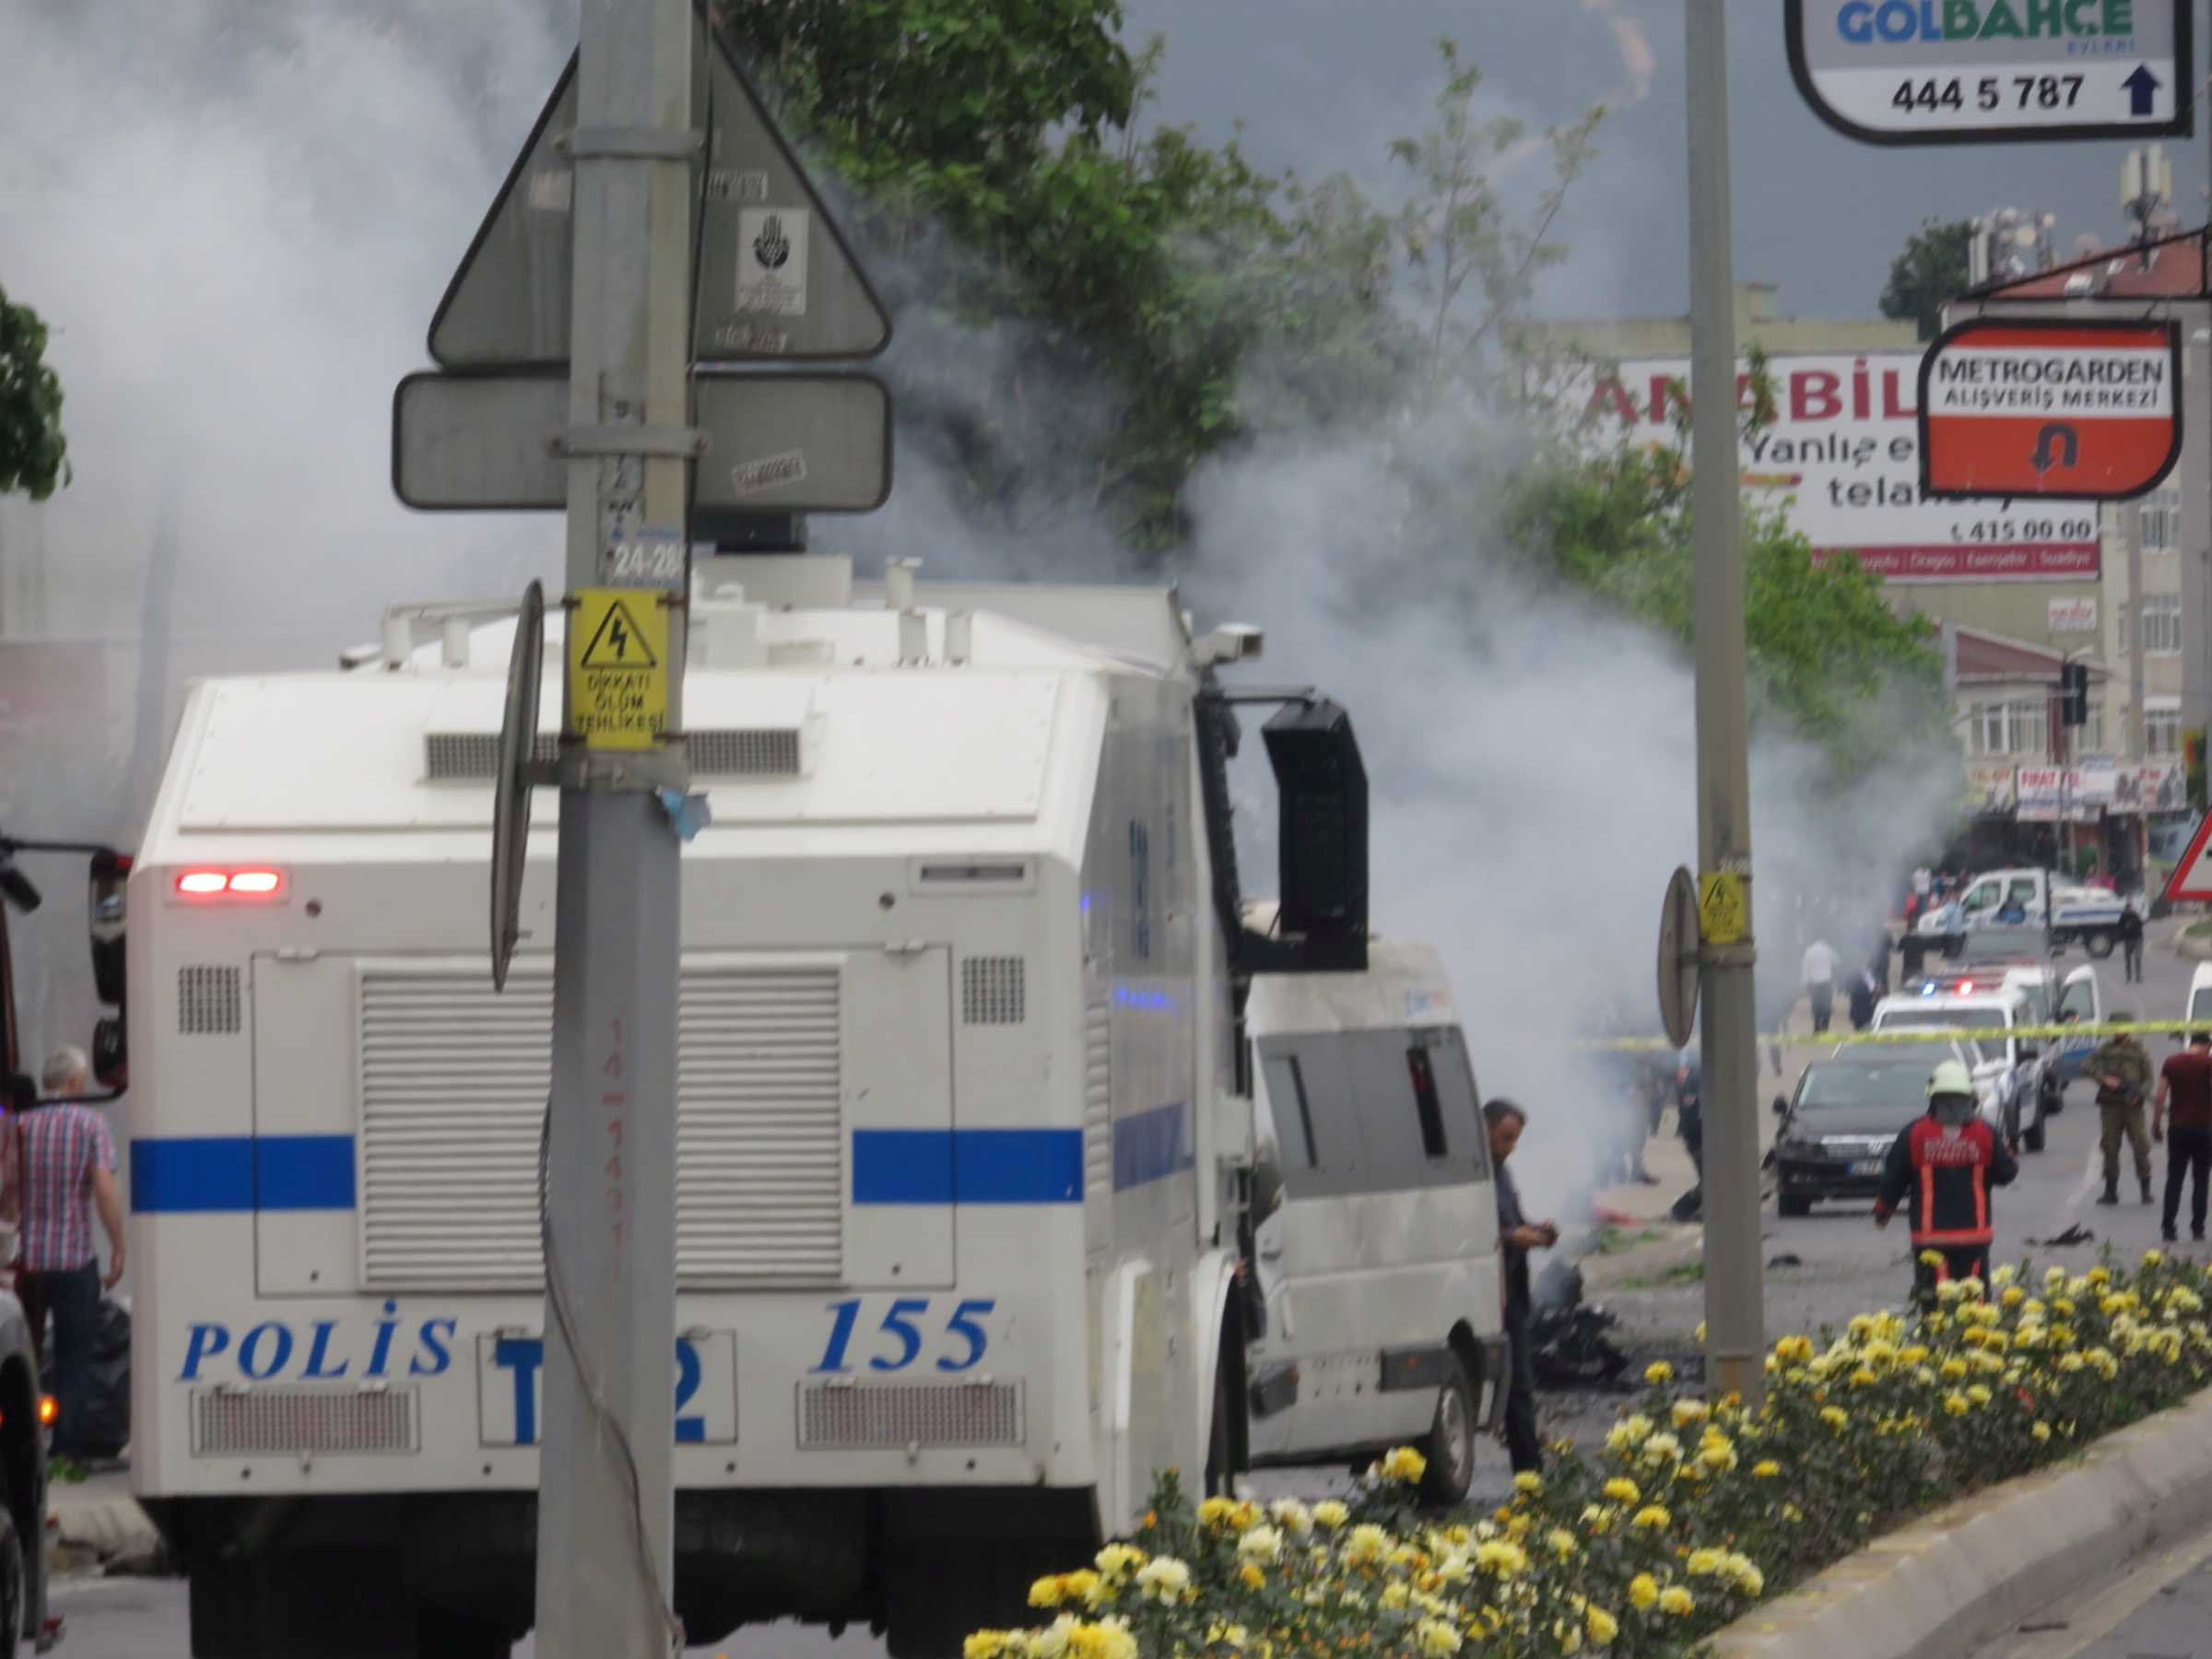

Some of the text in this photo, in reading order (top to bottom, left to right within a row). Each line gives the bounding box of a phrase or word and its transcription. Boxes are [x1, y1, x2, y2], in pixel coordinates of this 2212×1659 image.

[1892, 76, 2085, 112] 444 5 787
[1938, 358, 2163, 383] METROGARDEN
[1944, 385, 2158, 411] ALIŞVERİŞ MERKEZİ
[1970, 518, 2092, 541] 415 00 00
[177, 1299, 457, 1382] POLİS
[807, 1298, 995, 1374] 155
